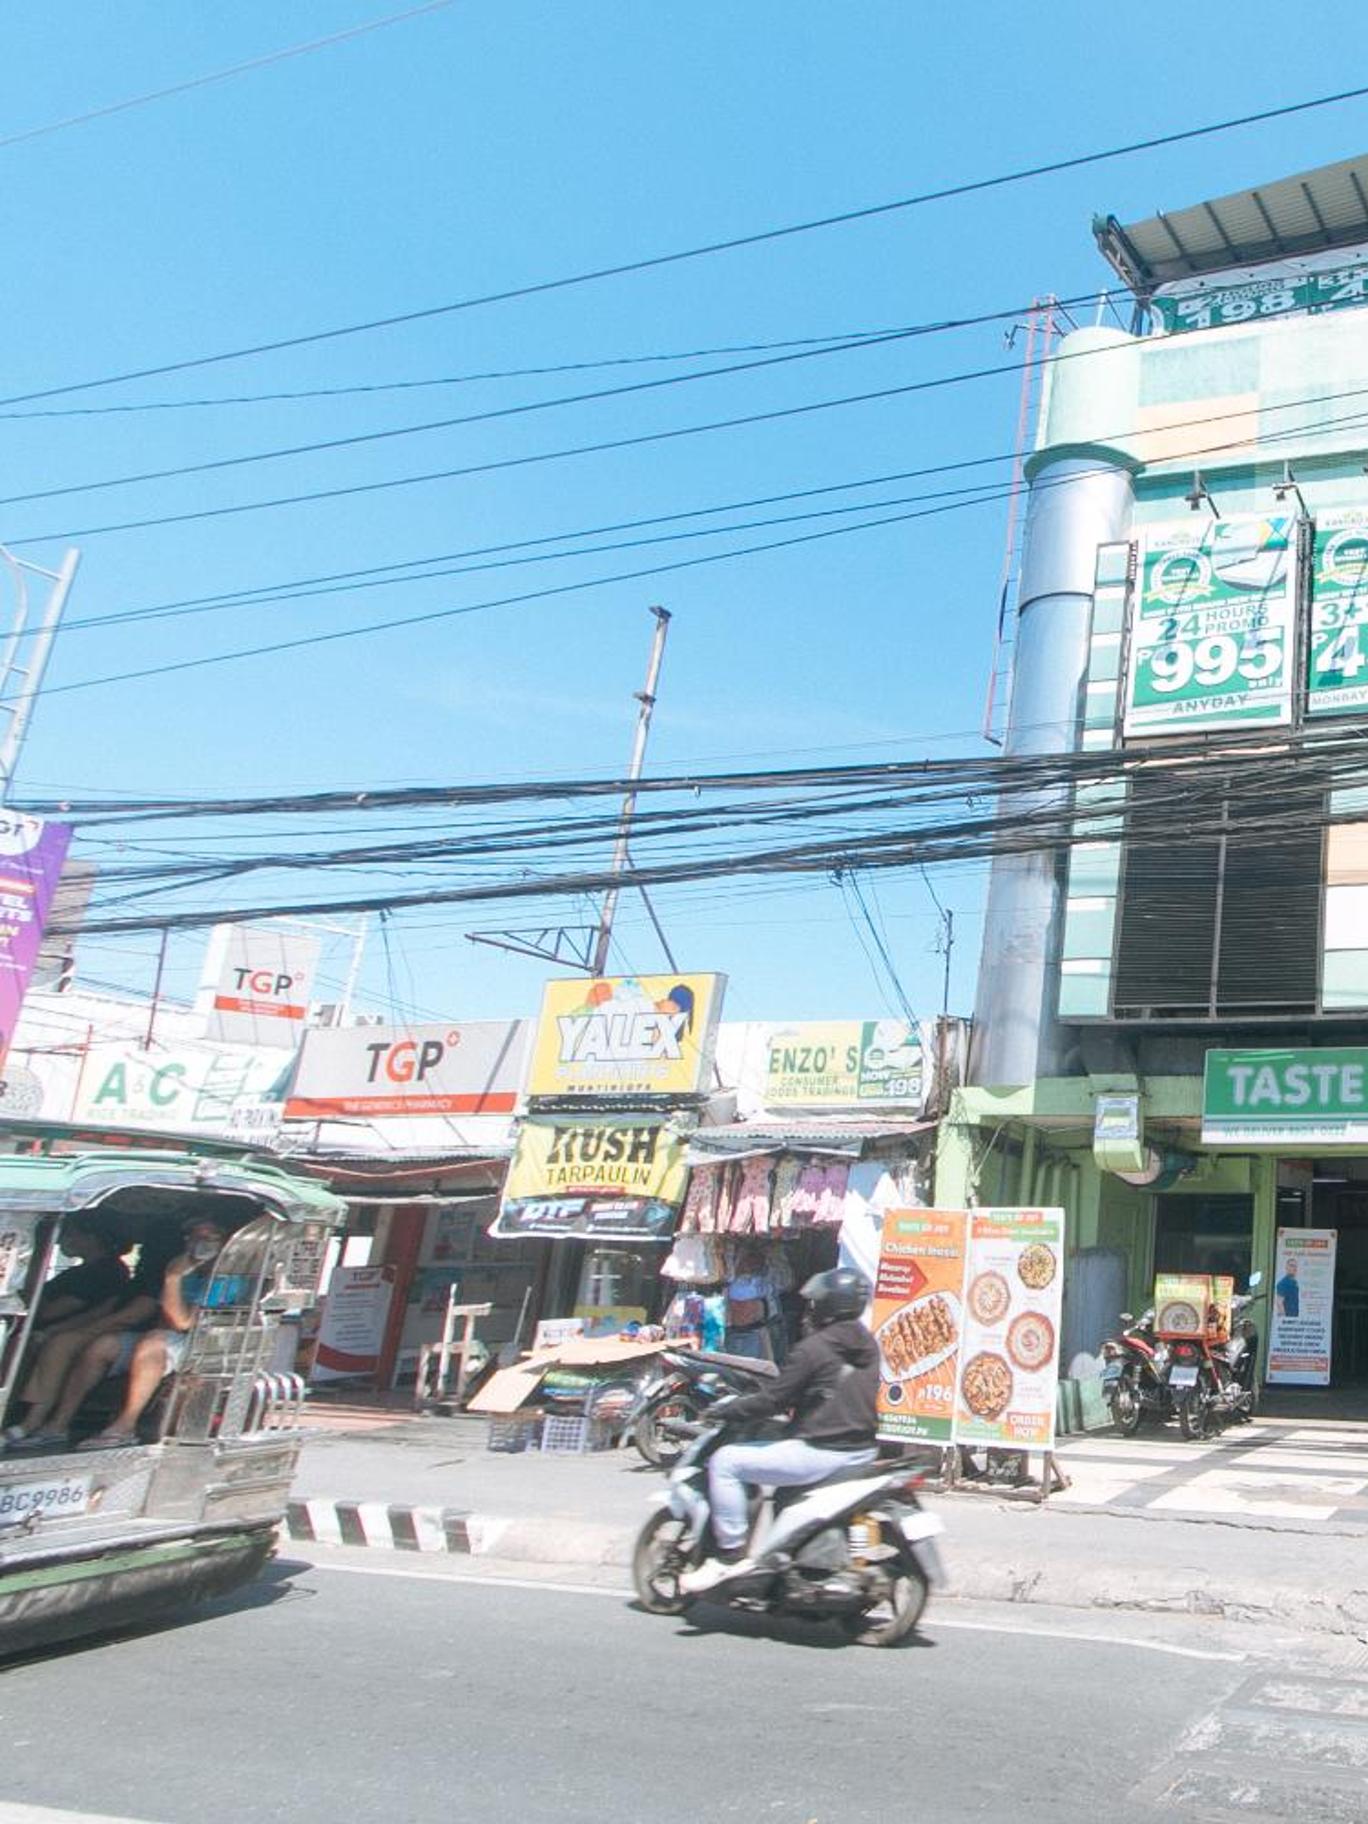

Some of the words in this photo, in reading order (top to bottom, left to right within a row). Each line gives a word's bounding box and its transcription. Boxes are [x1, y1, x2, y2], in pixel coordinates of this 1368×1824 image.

[1185, 288, 1297, 330] 198
[1204, 615, 1270, 635] PROMO
[1206, 602, 1269, 622] HOURS
[1160, 613, 1201, 641] 24
[1173, 694, 1249, 714] ANYDAY
[1312, 690, 1367, 705] MONDAY
[234, 967, 293, 995] TGP
[557, 1012, 689, 1063] YALEX
[366, 1040, 444, 1083] TGP
[93, 1062, 128, 1105] A
[150, 1062, 187, 1106] C
[780, 1075, 839, 1085] CONSUMER
[1226, 1063, 1365, 1107] TASTE
[546, 1125, 661, 1165] RUSH
[548, 1165, 651, 1186] TARPAULIN
